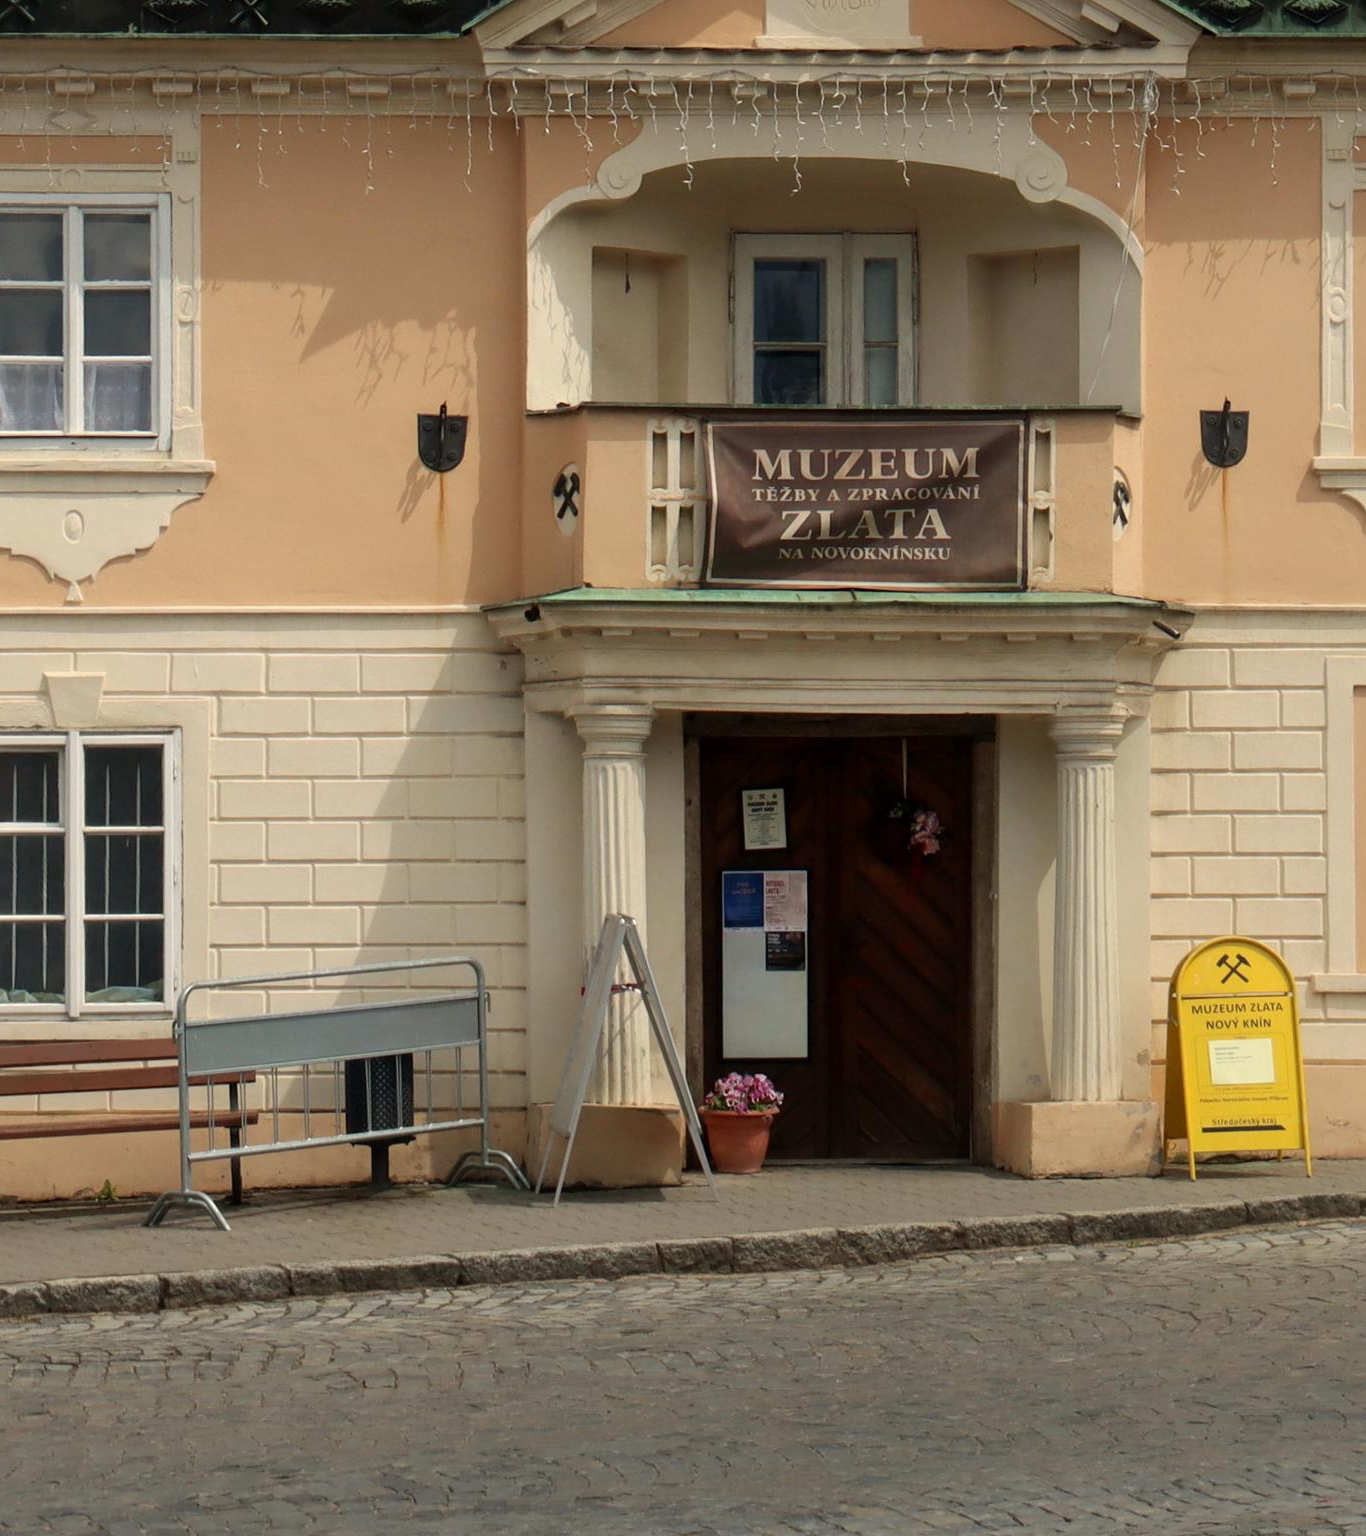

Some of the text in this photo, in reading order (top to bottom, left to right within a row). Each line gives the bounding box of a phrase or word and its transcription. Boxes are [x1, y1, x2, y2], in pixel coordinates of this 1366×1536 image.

[751, 447, 980, 481] MUZEUM
[751, 483, 980, 502] TĚŽBY A ZPRACOVÁNÍ
[779, 507, 952, 541] ZLATA
[778, 545, 951, 561] NA NOVOKNÍNSKU
[1191, 1002, 1283, 1015] MUZEUM ZLATA
[1206, 1016, 1272, 1030] NOVÝ KNÍN
[1211, 1116, 1277, 1127] Středočeský kraj
